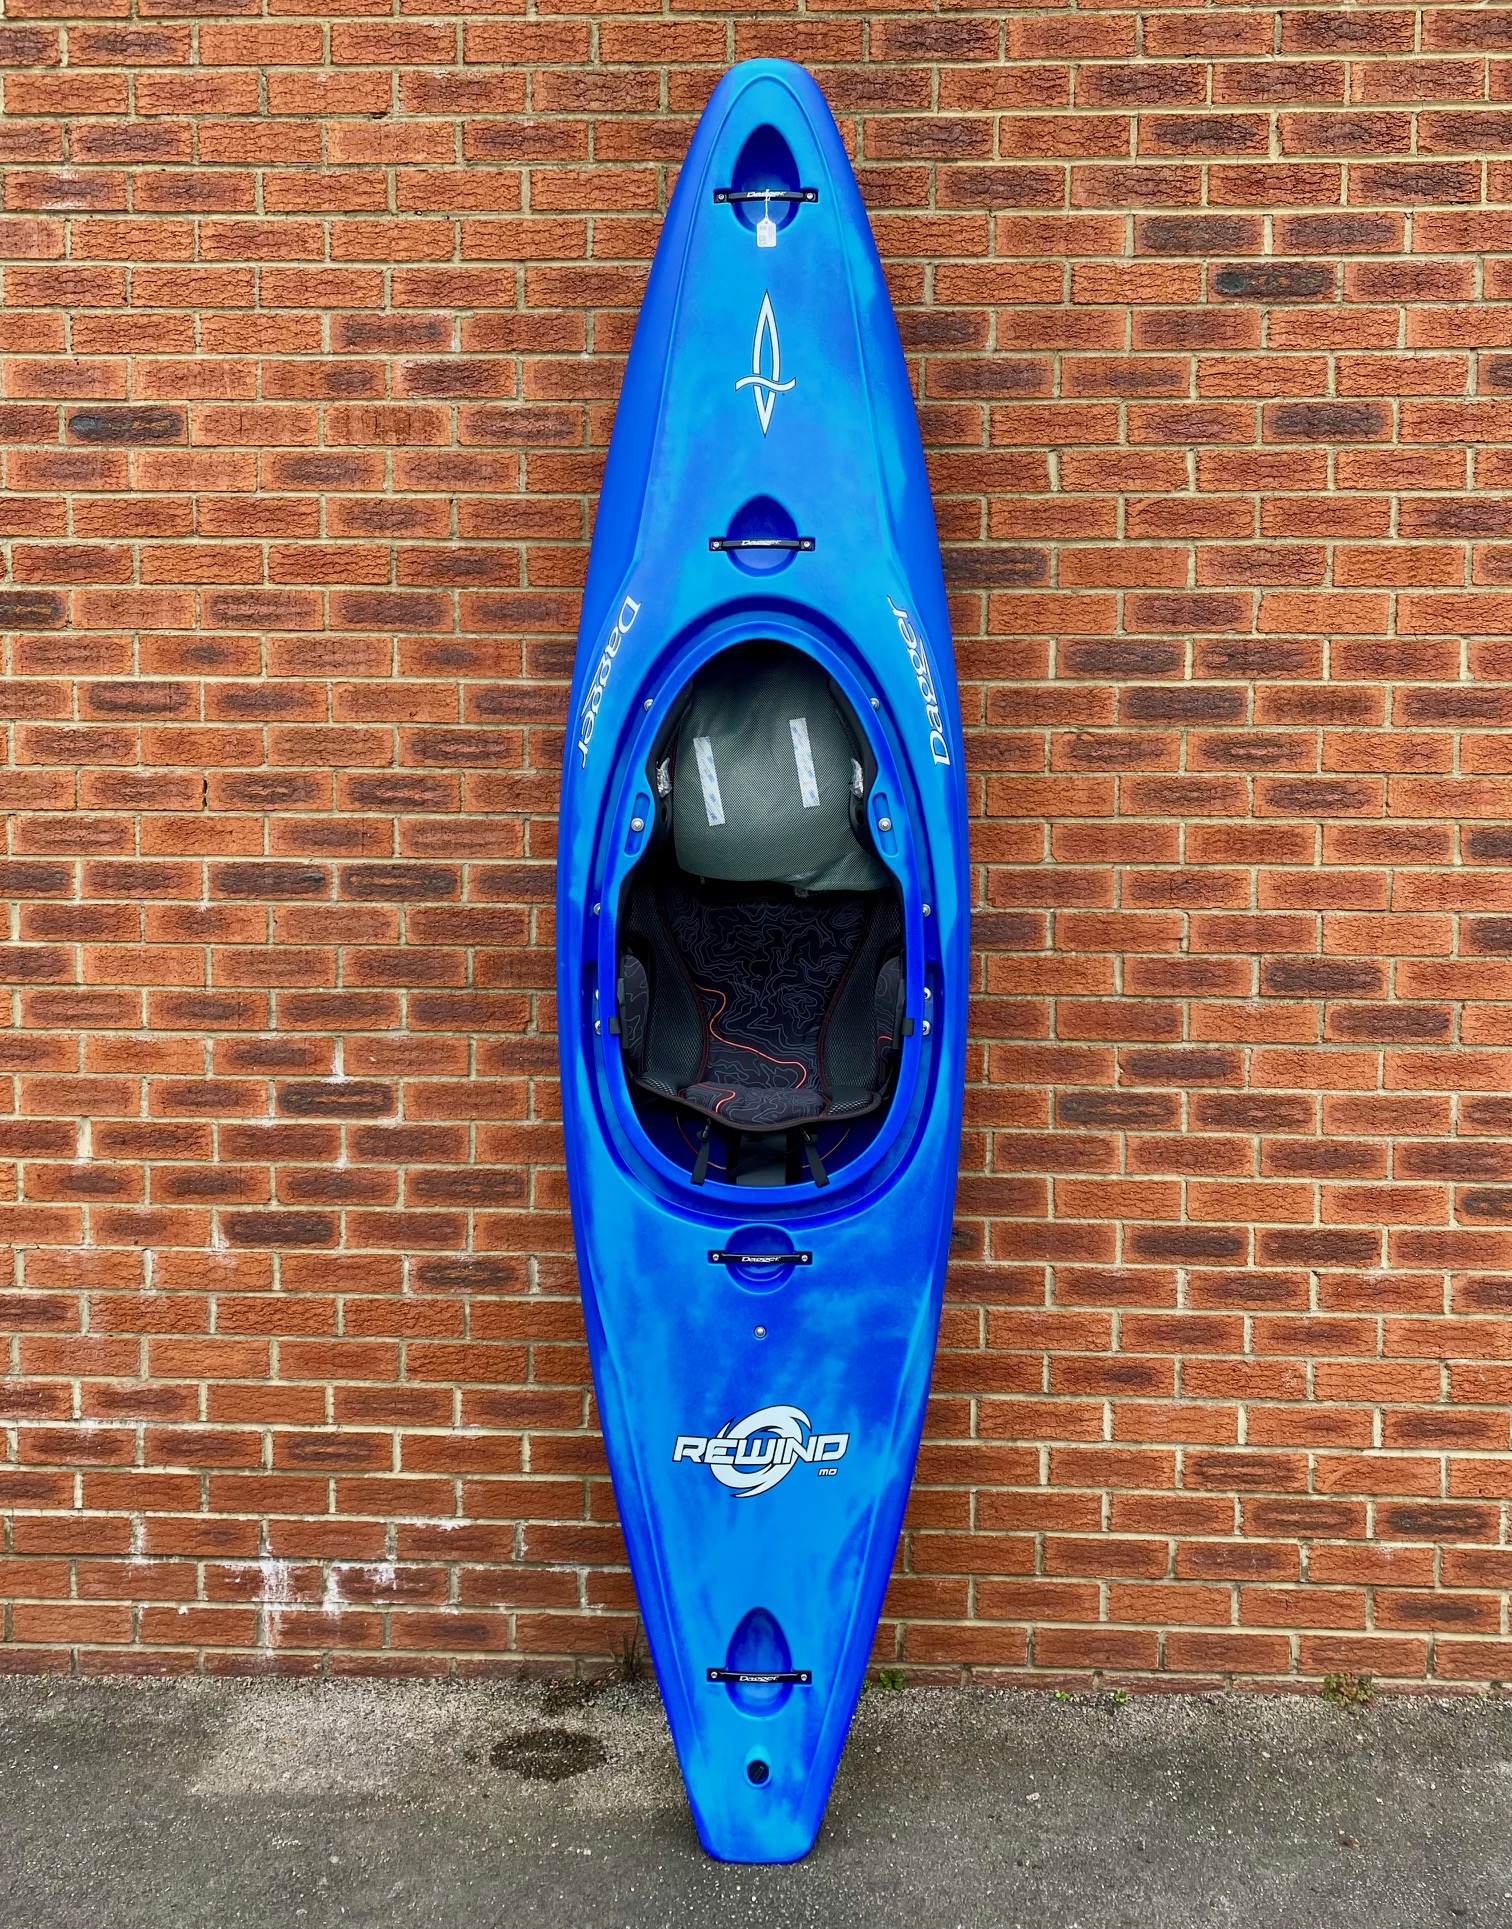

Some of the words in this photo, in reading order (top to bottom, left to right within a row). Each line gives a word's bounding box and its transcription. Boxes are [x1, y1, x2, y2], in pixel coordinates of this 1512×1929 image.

[577, 595, 642, 770] Dagger
[887, 594, 951, 767] Dagger
[672, 1433, 851, 1465] REWIND
[739, 1675, 780, 1683] Dagger
